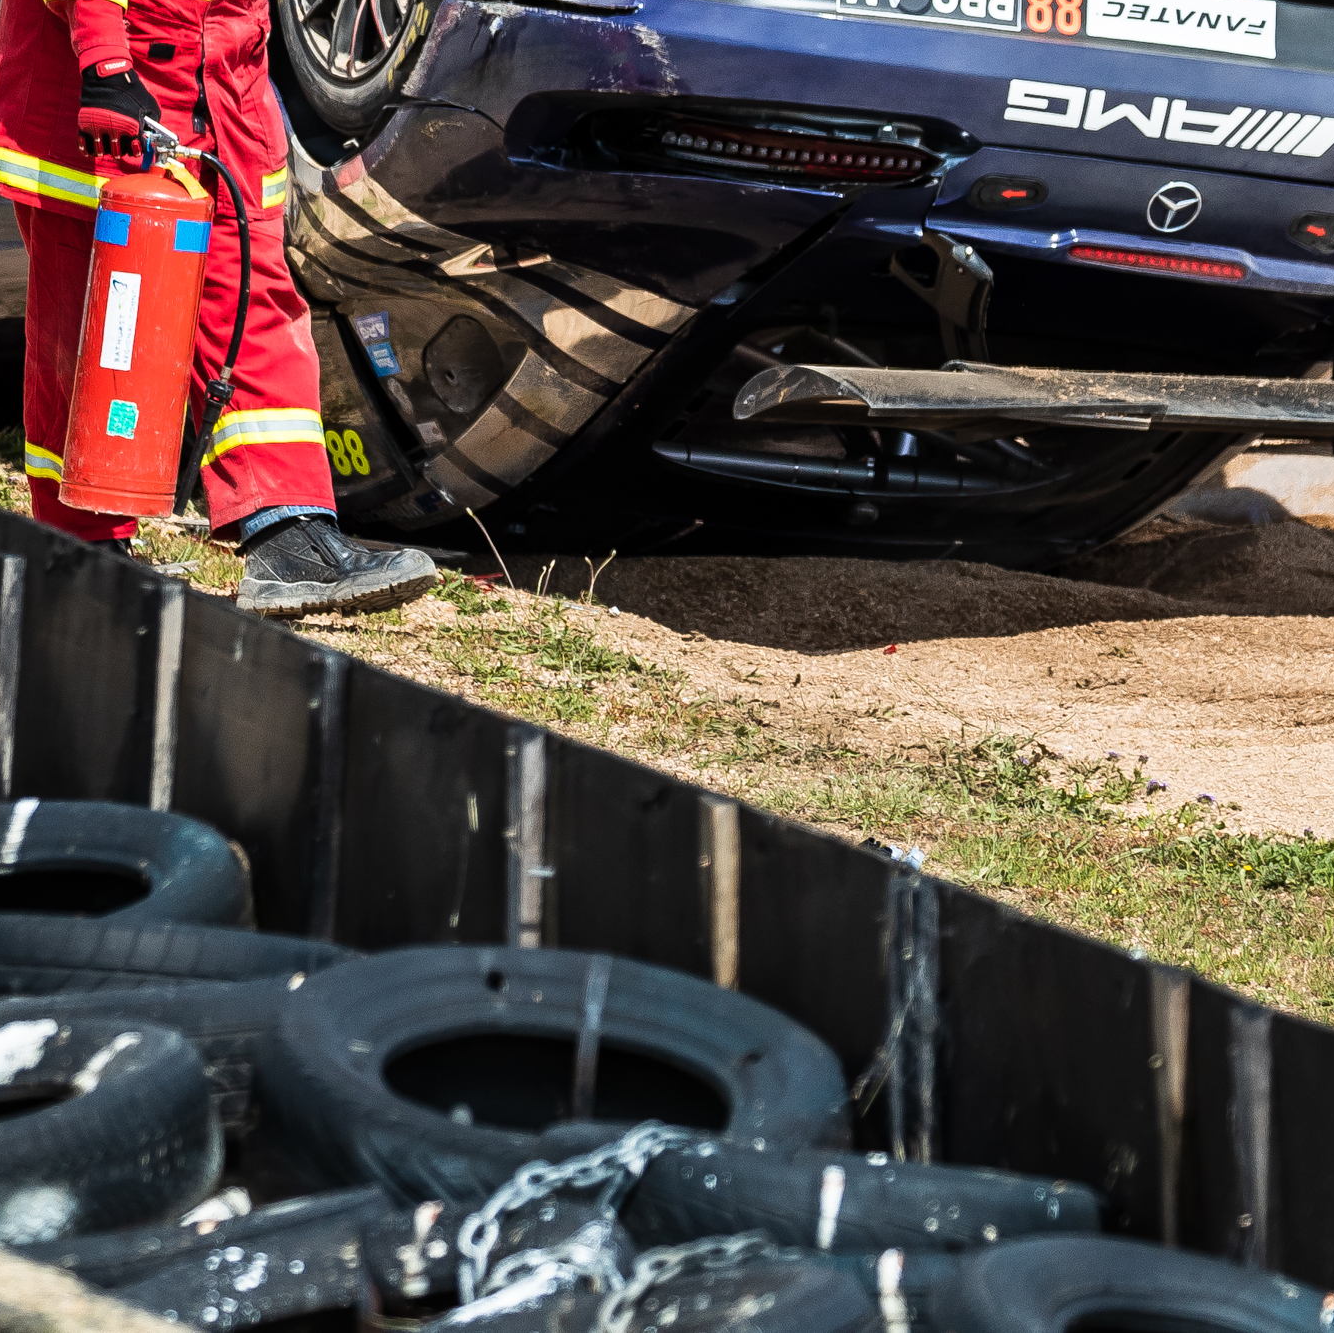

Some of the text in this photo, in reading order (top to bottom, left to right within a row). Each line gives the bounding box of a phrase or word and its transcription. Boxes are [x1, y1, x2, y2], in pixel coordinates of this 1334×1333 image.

[1102, 1, 1267, 36] FANATEC
[1004, 78, 1253, 148] AMG
[325, 429, 370, 477] 88
